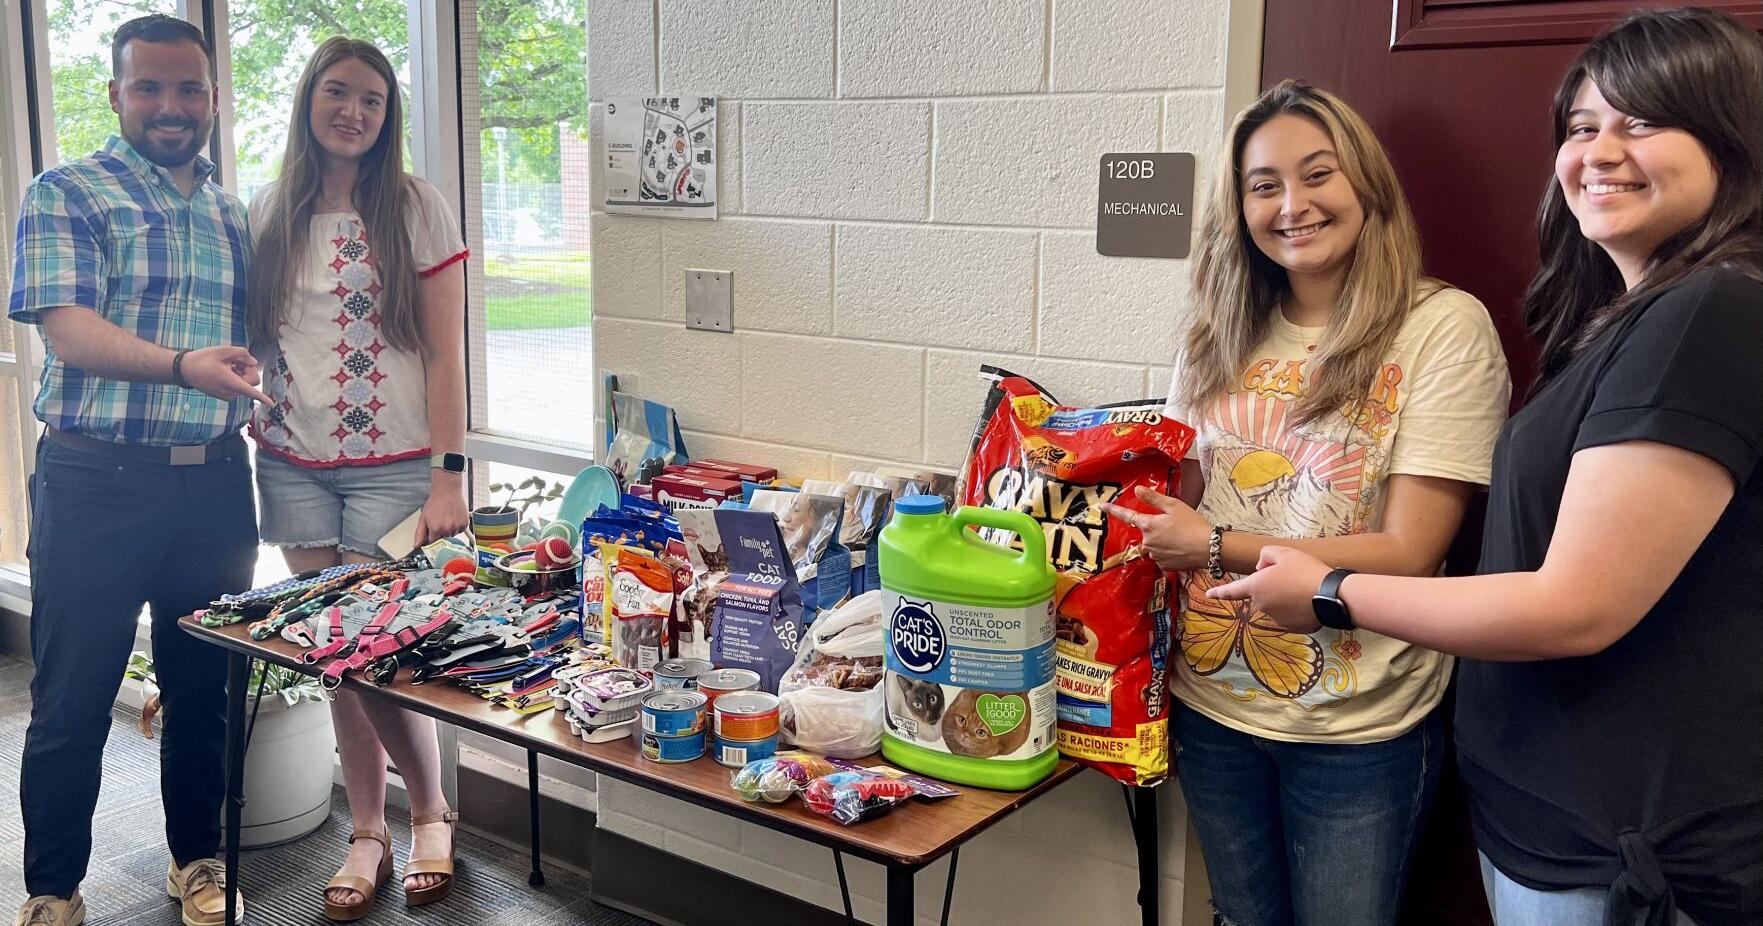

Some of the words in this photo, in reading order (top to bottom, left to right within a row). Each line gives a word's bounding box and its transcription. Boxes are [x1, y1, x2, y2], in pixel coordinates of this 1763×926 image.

[1107, 160, 1155, 179] 120B
[1104, 202, 1184, 216] MECHANICAL
[1100, 410, 1163, 426] GRAVY
[663, 499, 713, 514] MILK-BO
[758, 562, 780, 575] CAT
[746, 572, 782, 585] FOOD
[627, 595, 641, 610] Fun
[720, 592, 742, 601] CHICKEN,
[758, 598, 770, 606] AND
[725, 599, 746, 608] SALMON
[746, 603, 769, 612] FLAVORS
[949, 609, 994, 618] UNSCENTED
[898, 613, 934, 635] CAT'S
[950, 616, 983, 628] TOTAL
[986, 620, 1021, 630] ODOR
[774, 625, 790, 650] CAT
[784, 620, 799, 653] OOD
[950, 626, 1003, 639] CONTROL
[894, 629, 940, 657] PRIDE
[1056, 656, 1070, 670] AKES
[1071, 661, 1086, 676] RICH
[1061, 676, 1073, 690] UNA
[1074, 680, 1091, 695] SALSA
[1147, 667, 1161, 719] GRAVY
[986, 701, 1020, 712] LITTER
[989, 709, 1016, 718] GOOD
